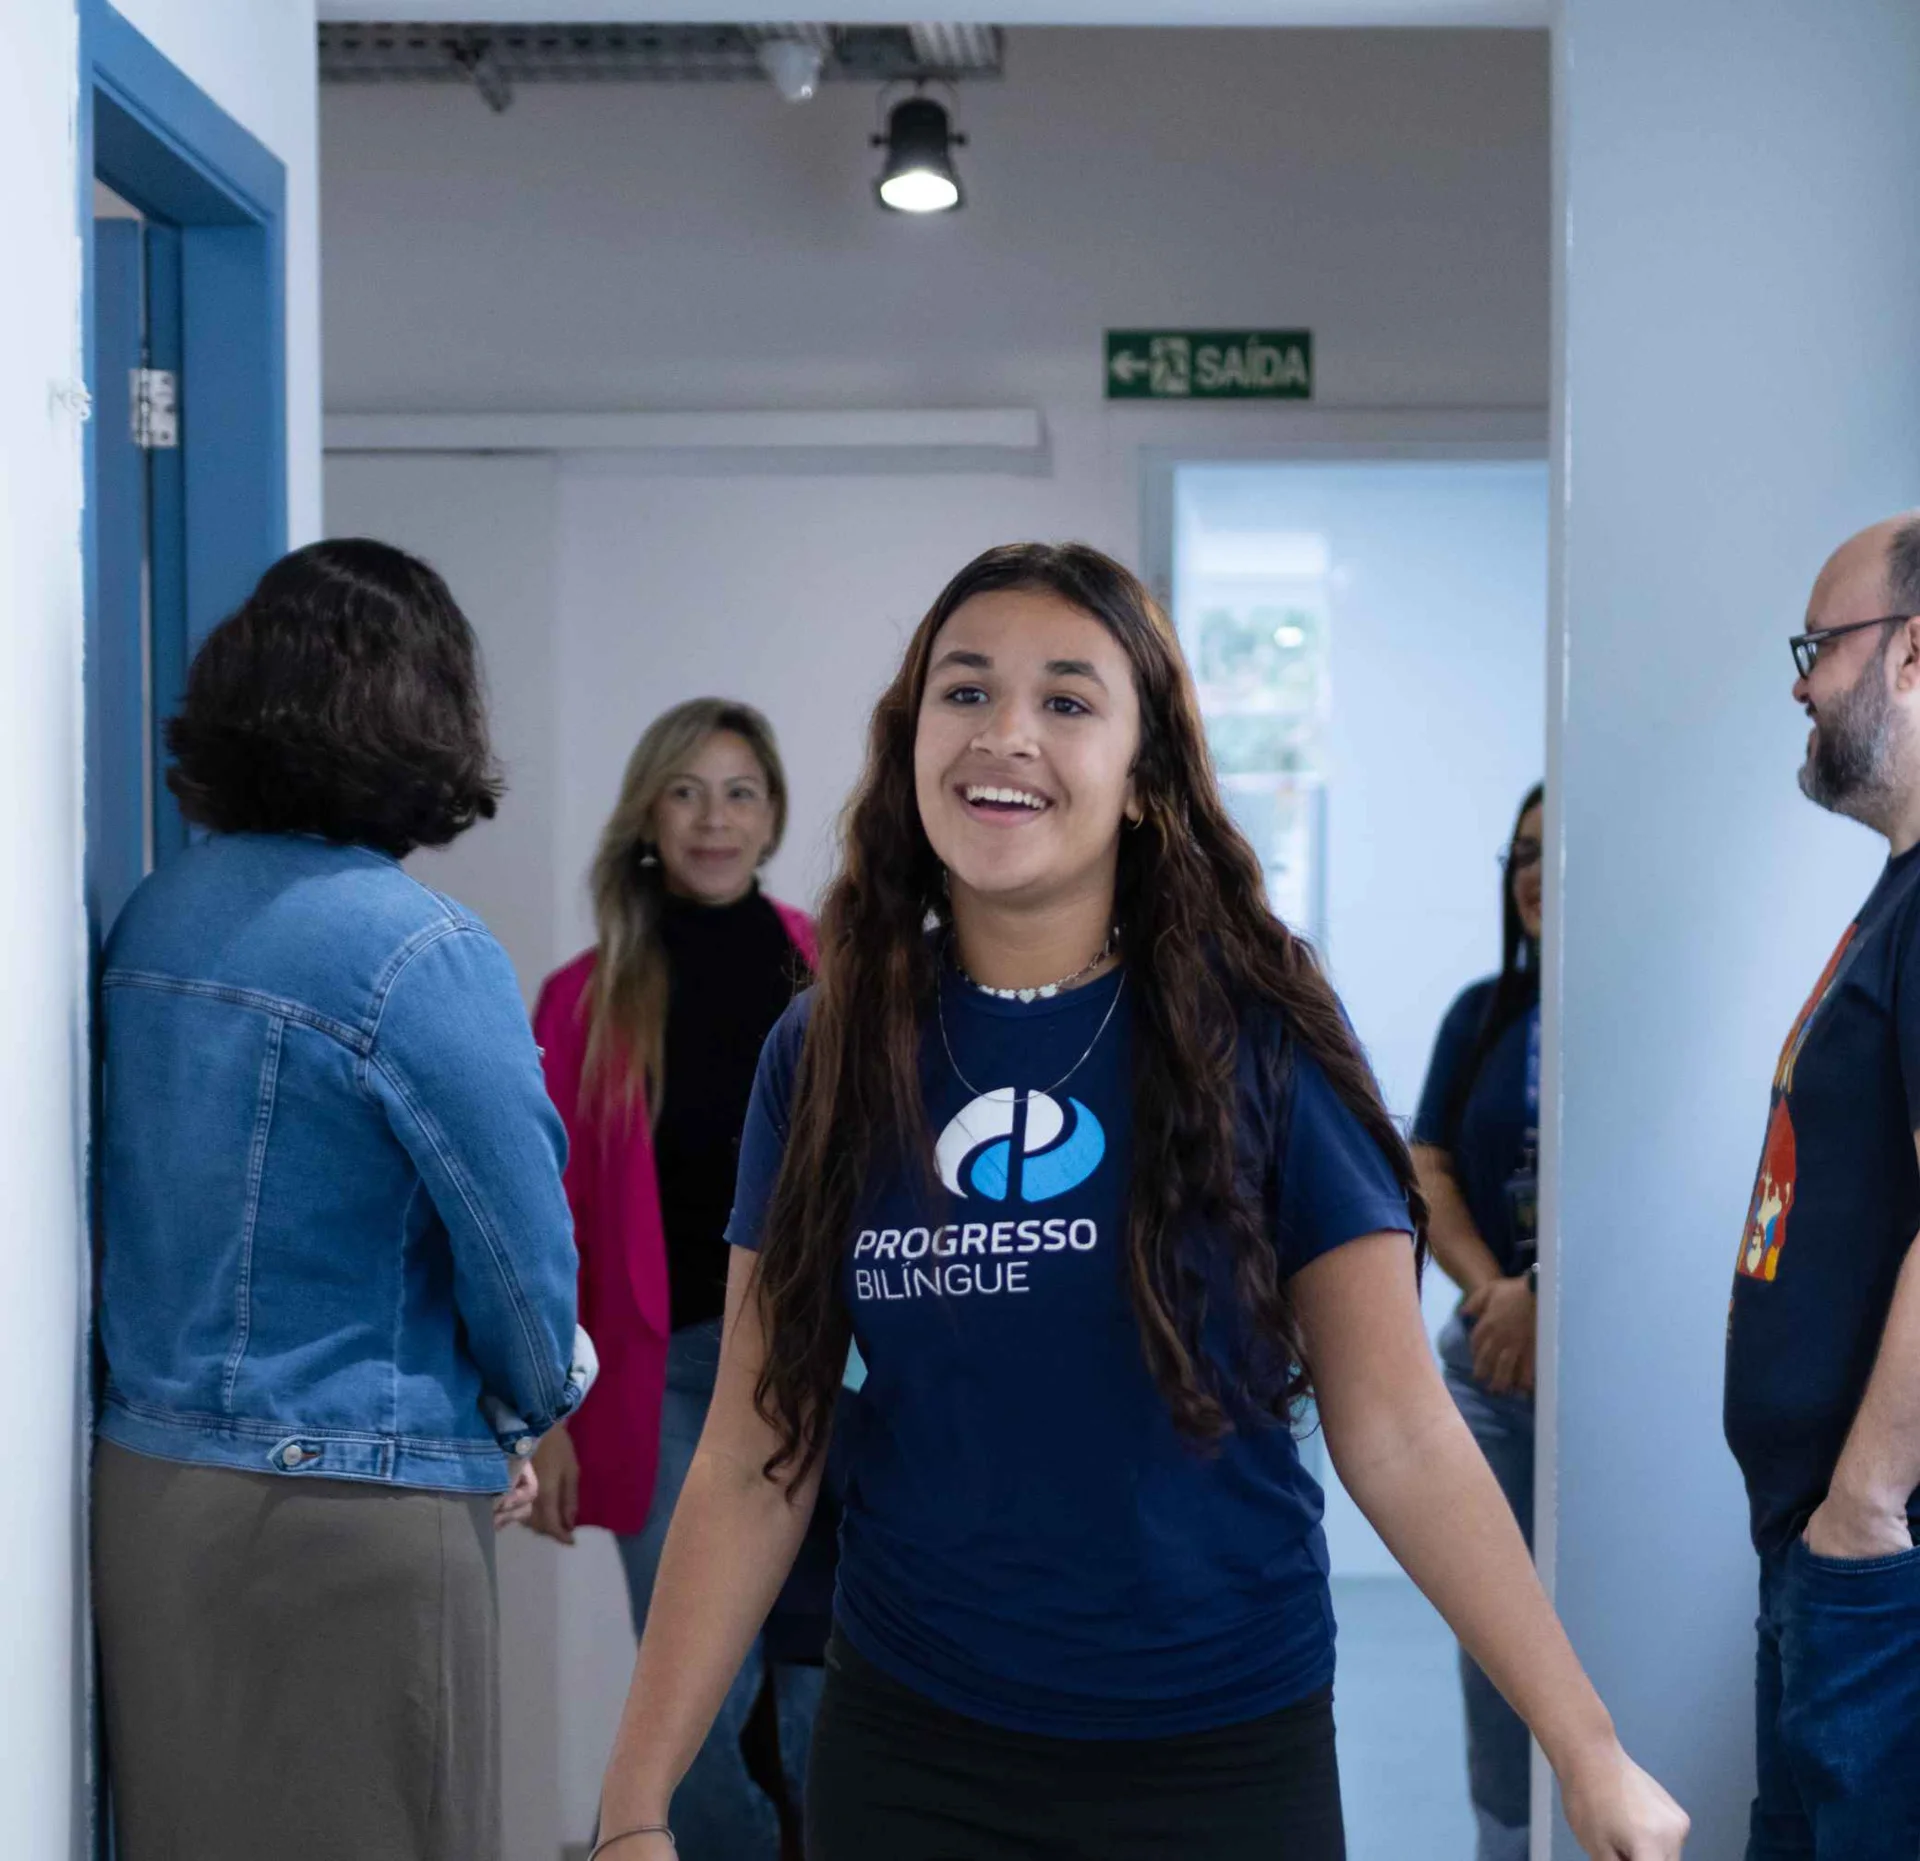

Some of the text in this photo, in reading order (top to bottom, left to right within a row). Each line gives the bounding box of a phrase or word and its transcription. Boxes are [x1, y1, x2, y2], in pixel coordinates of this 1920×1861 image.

[1197, 335, 1307, 388] SAÍDA
[854, 1218, 1097, 1259] PROGRESSO
[855, 1260, 1030, 1300] BILÍNGUE
